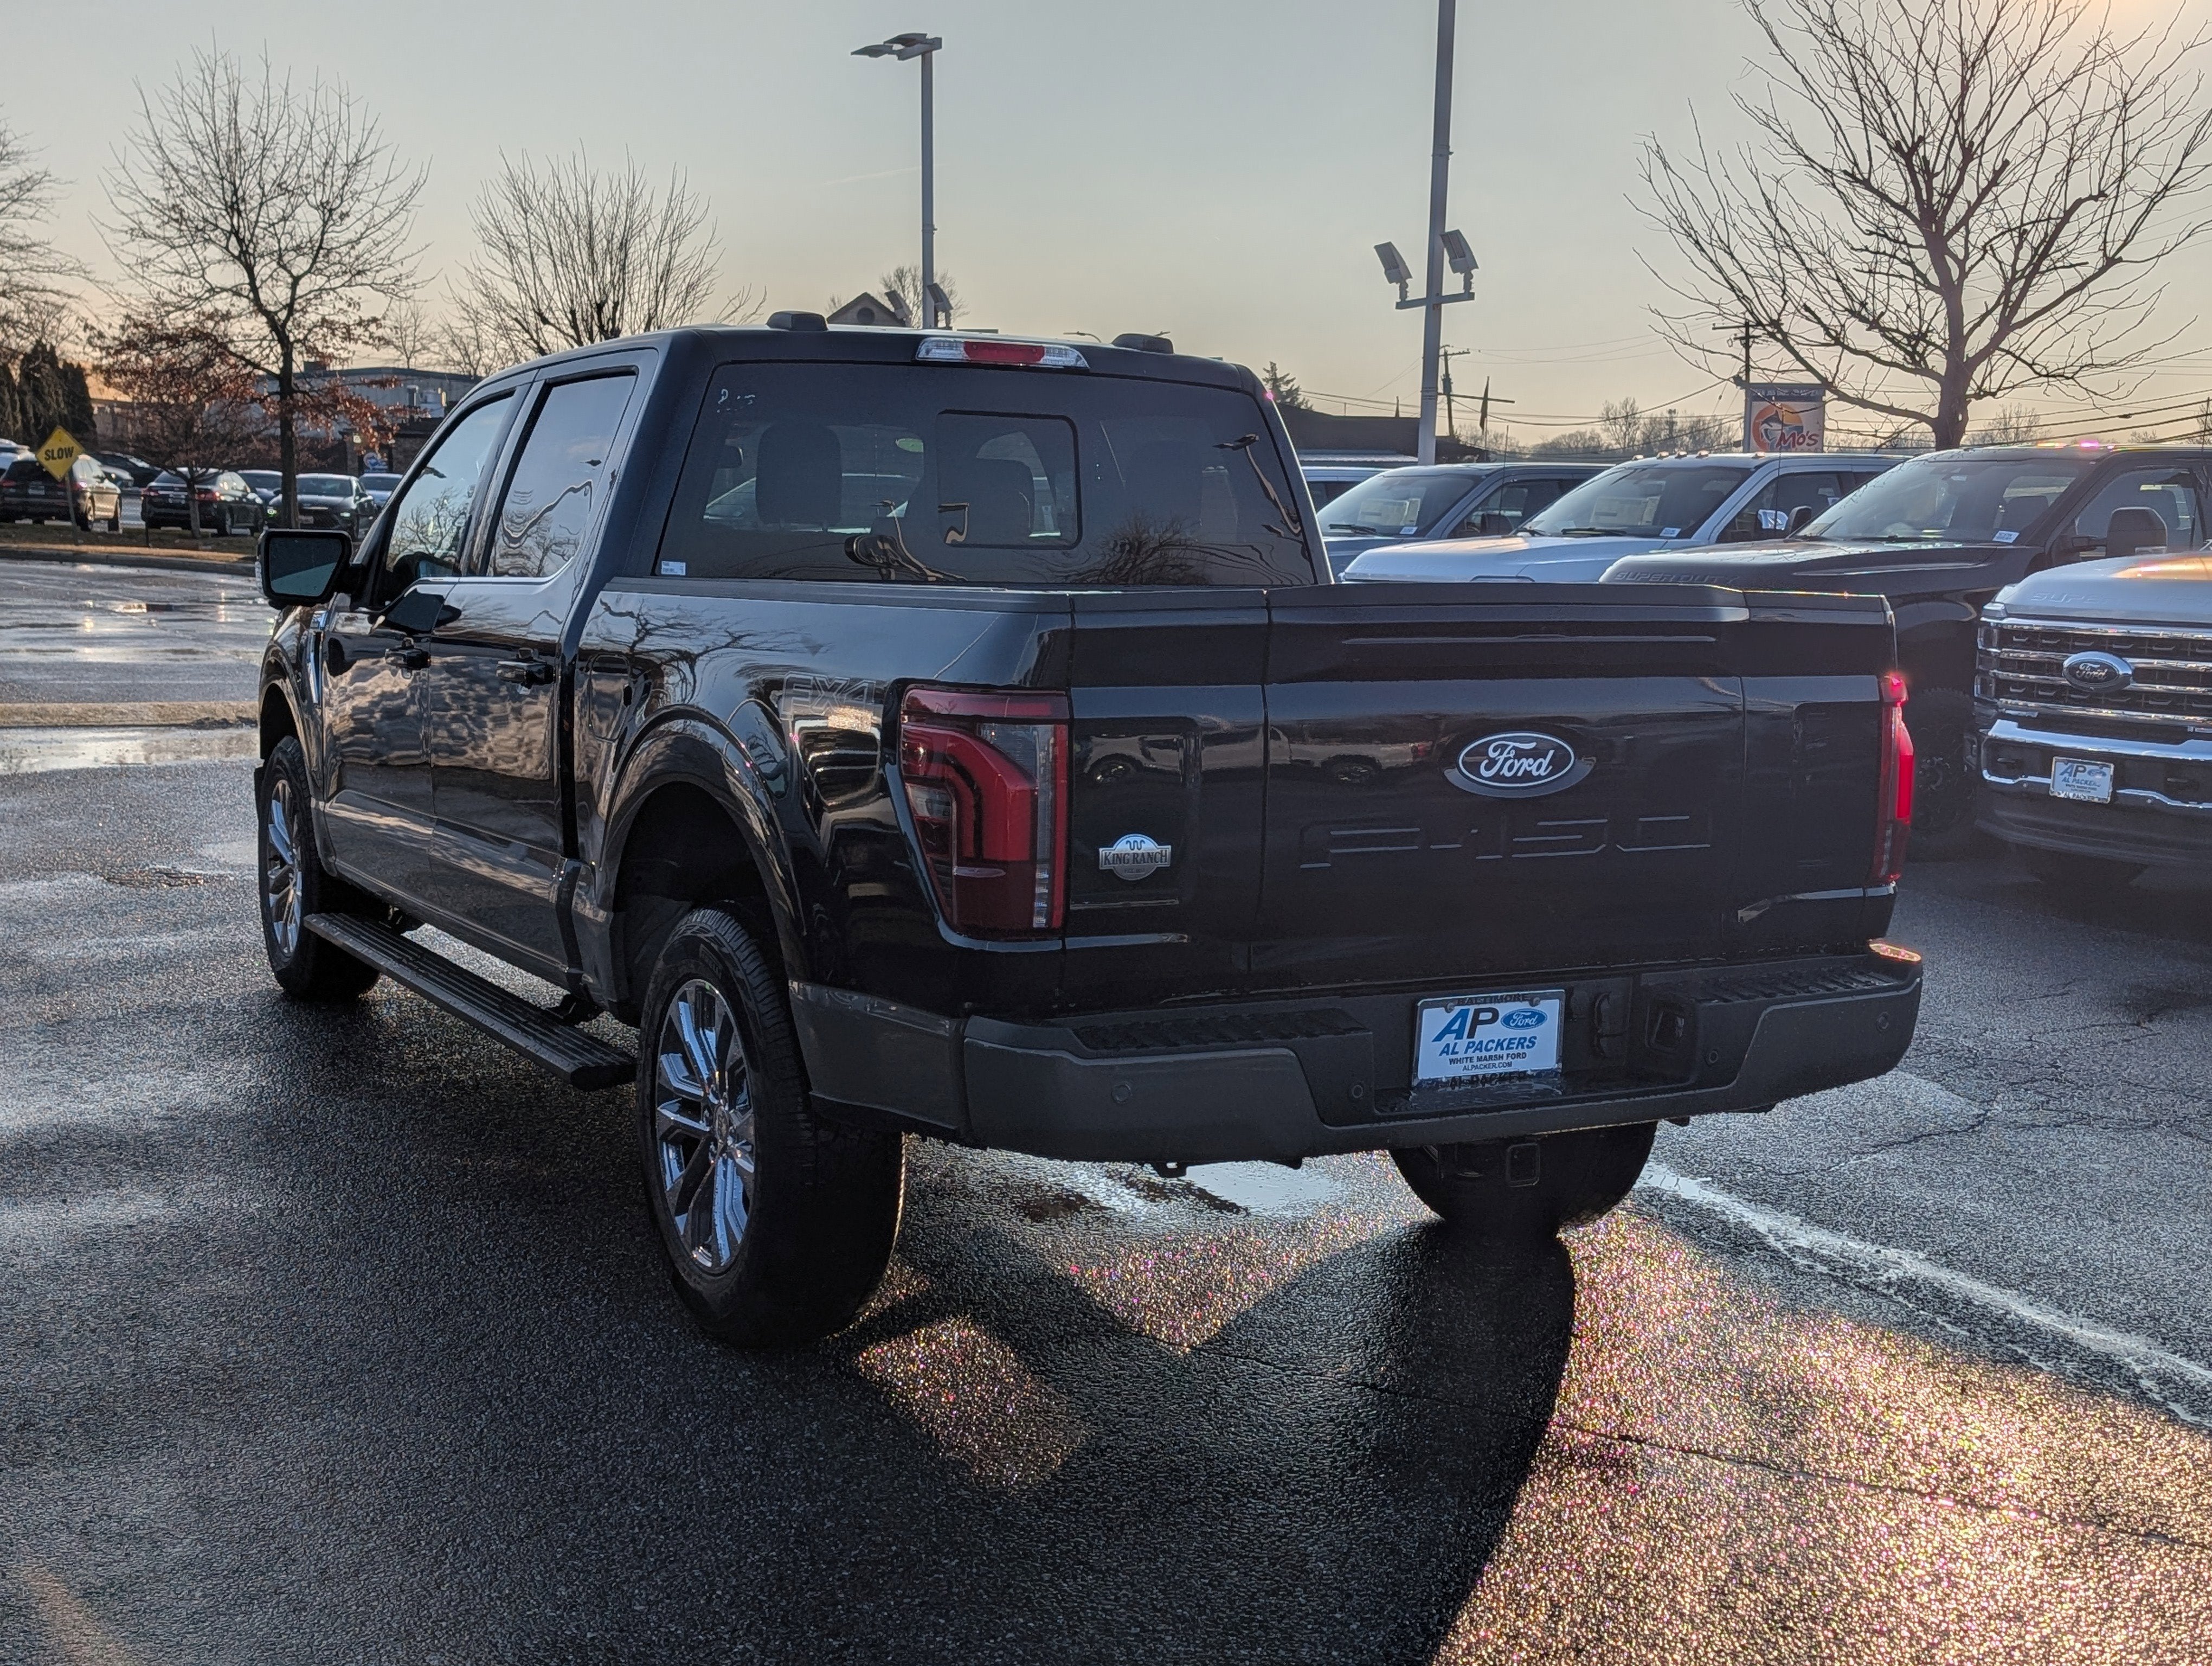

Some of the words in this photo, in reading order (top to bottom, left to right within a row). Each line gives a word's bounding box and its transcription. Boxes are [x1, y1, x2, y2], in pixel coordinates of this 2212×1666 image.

[1775, 431, 1820, 449] Mo's
[44, 447, 74, 461] SLOW
[1614, 571, 1676, 582] SUPER
[2075, 662, 2108, 680] Ford
[1480, 740, 1555, 778] Ford
[2059, 764, 2087, 778] AP
[1104, 851, 1130, 866] KING
[1133, 849, 1168, 864] RANCH
[1431, 1007, 1500, 1043] AP
[1510, 1012, 1538, 1027] Ford
[1438, 1042, 1459, 1056] AL
[1464, 1035, 1538, 1055] PACKERS
[1449, 1056, 1475, 1066] WHITE
[1476, 1054, 1504, 1063] MARSH
[1506, 1052, 1527, 1060] FORD
[1462, 1061, 1513, 1072] ALPACKER.COM
